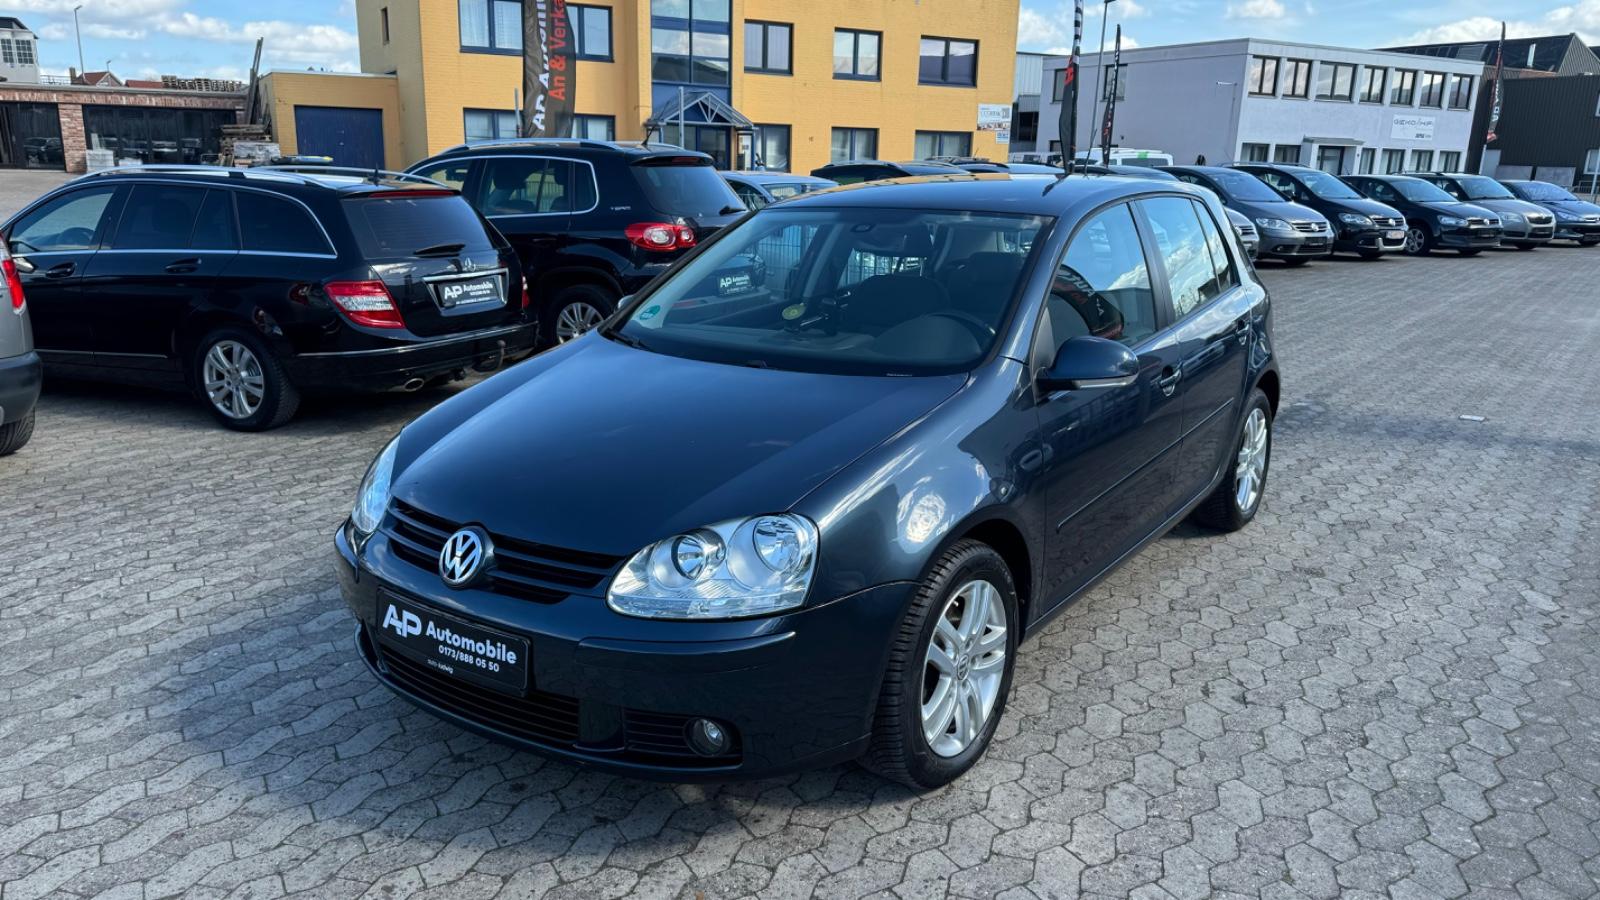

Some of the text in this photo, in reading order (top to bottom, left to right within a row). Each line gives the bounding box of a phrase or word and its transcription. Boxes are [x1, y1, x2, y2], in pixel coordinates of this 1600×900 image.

[549, 55, 566, 72] &
[548, 76, 566, 101] An
[444, 285, 463, 300] AP
[382, 603, 517, 665] AP Automobile
[438, 644, 500, 673] 0173/888 05 50
